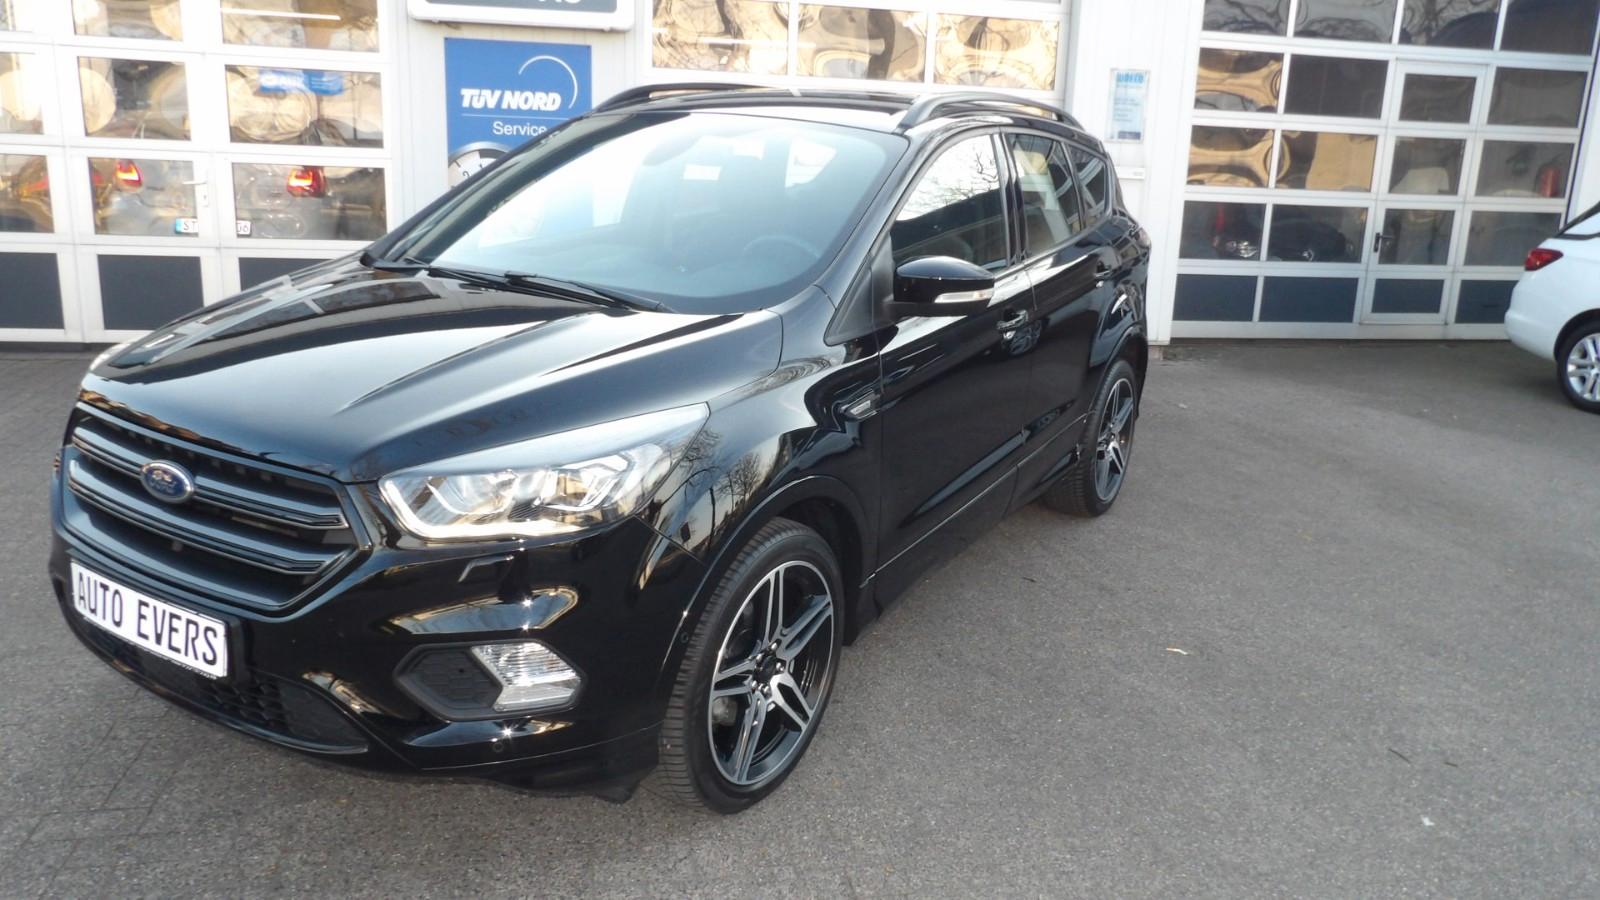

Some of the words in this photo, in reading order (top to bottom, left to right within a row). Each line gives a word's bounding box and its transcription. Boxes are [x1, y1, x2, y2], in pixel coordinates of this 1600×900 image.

[460, 88, 501, 109] TÜV
[502, 91, 561, 111] NORD
[78, 572, 123, 628] AUTO
[137, 598, 218, 666] EVERS
